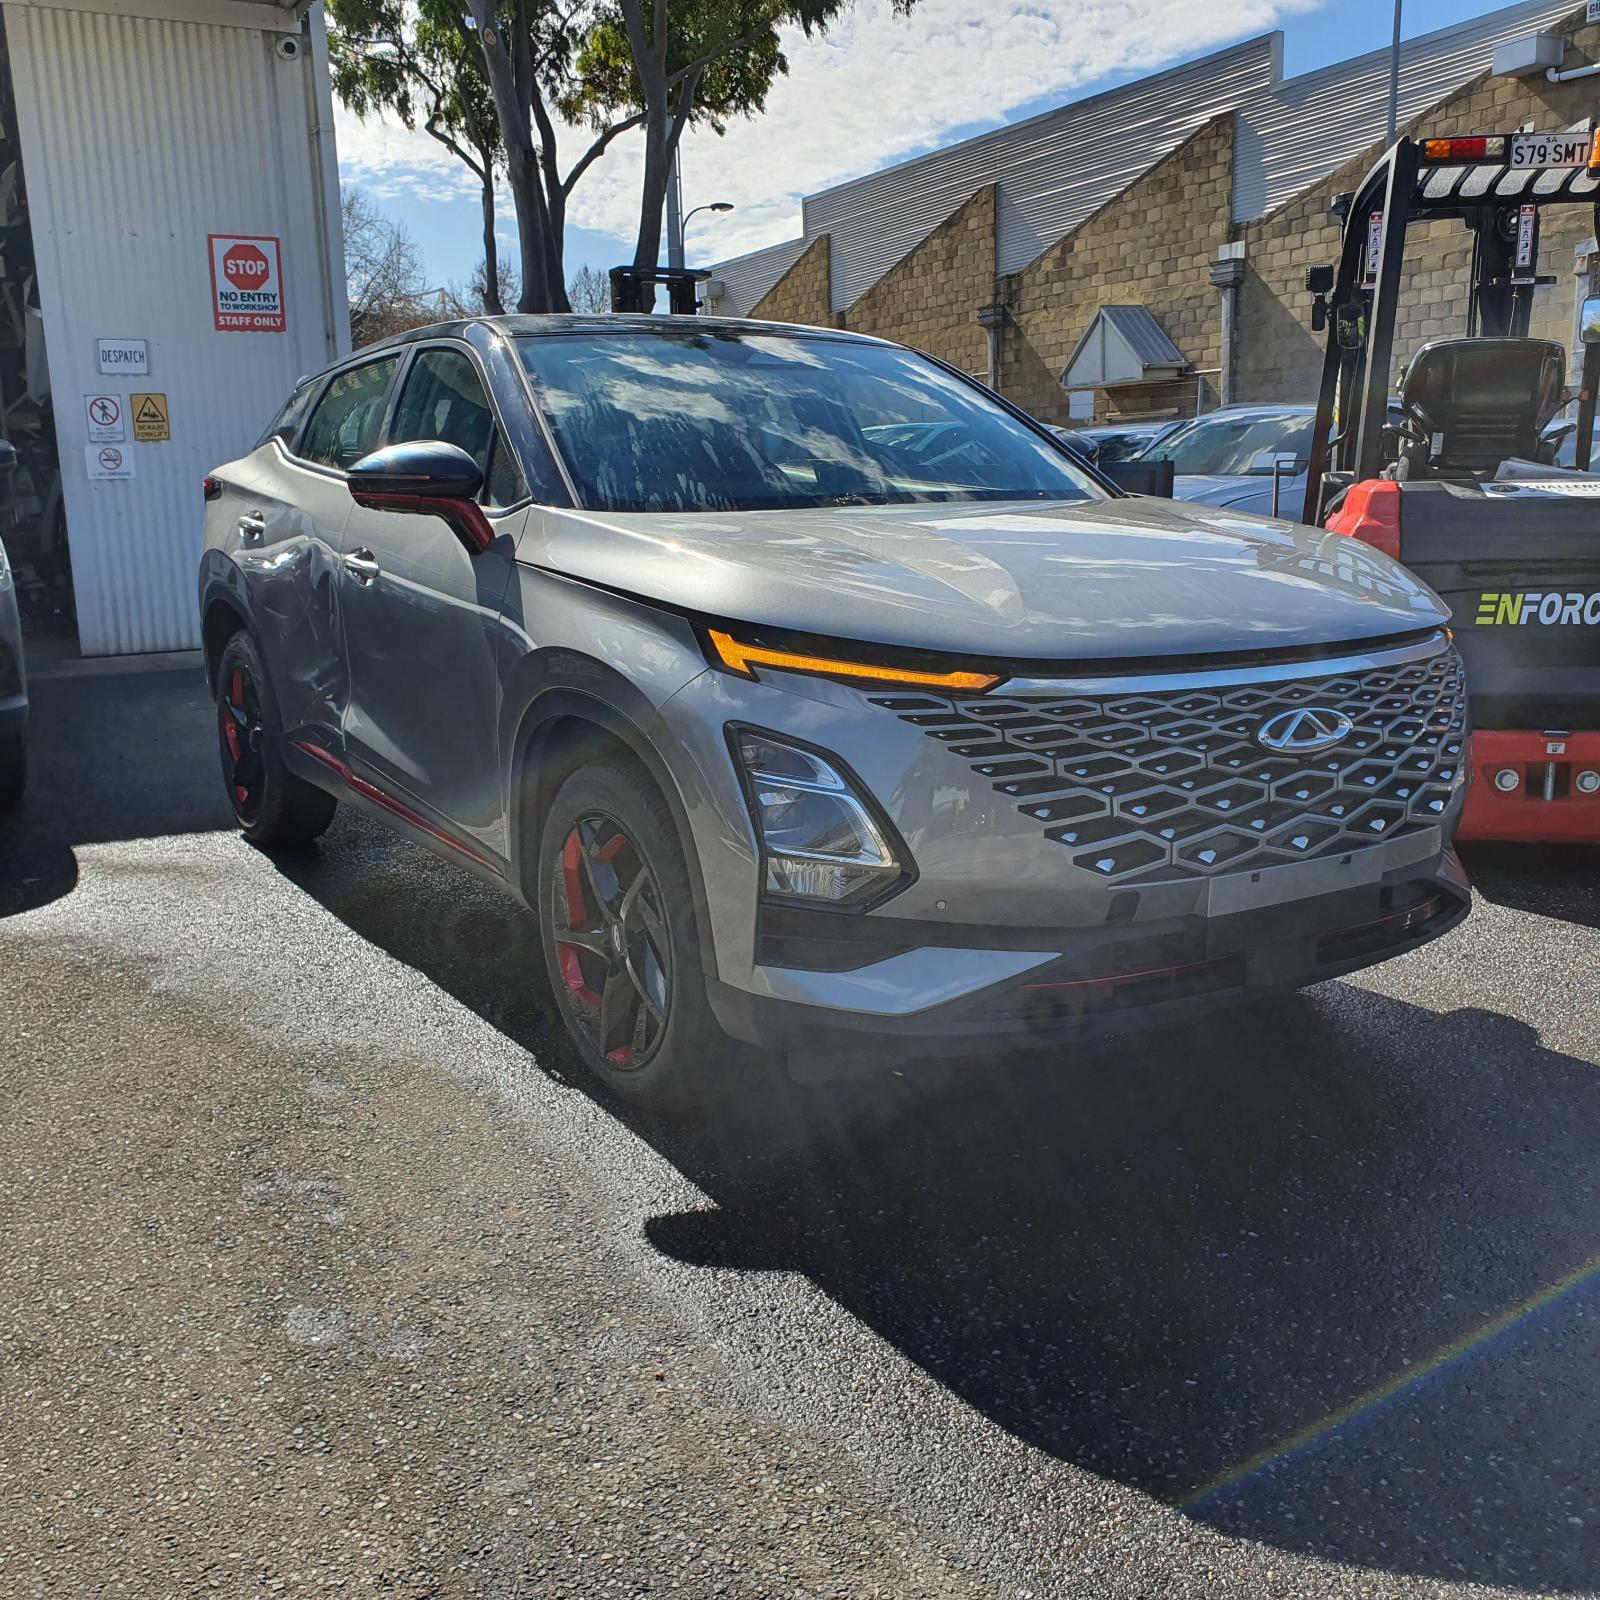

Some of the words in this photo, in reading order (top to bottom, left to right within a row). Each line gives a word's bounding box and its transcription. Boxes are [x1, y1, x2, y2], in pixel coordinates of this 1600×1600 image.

[227, 260, 266, 275] STOP
[220, 292, 238, 301] NO
[240, 292, 278, 303] ENTRY
[219, 316, 252, 325] STAFF
[254, 317, 282, 326] ONLY
[101, 349, 145, 363] DESPATCH
[1475, 592, 1600, 625] ENFORC
